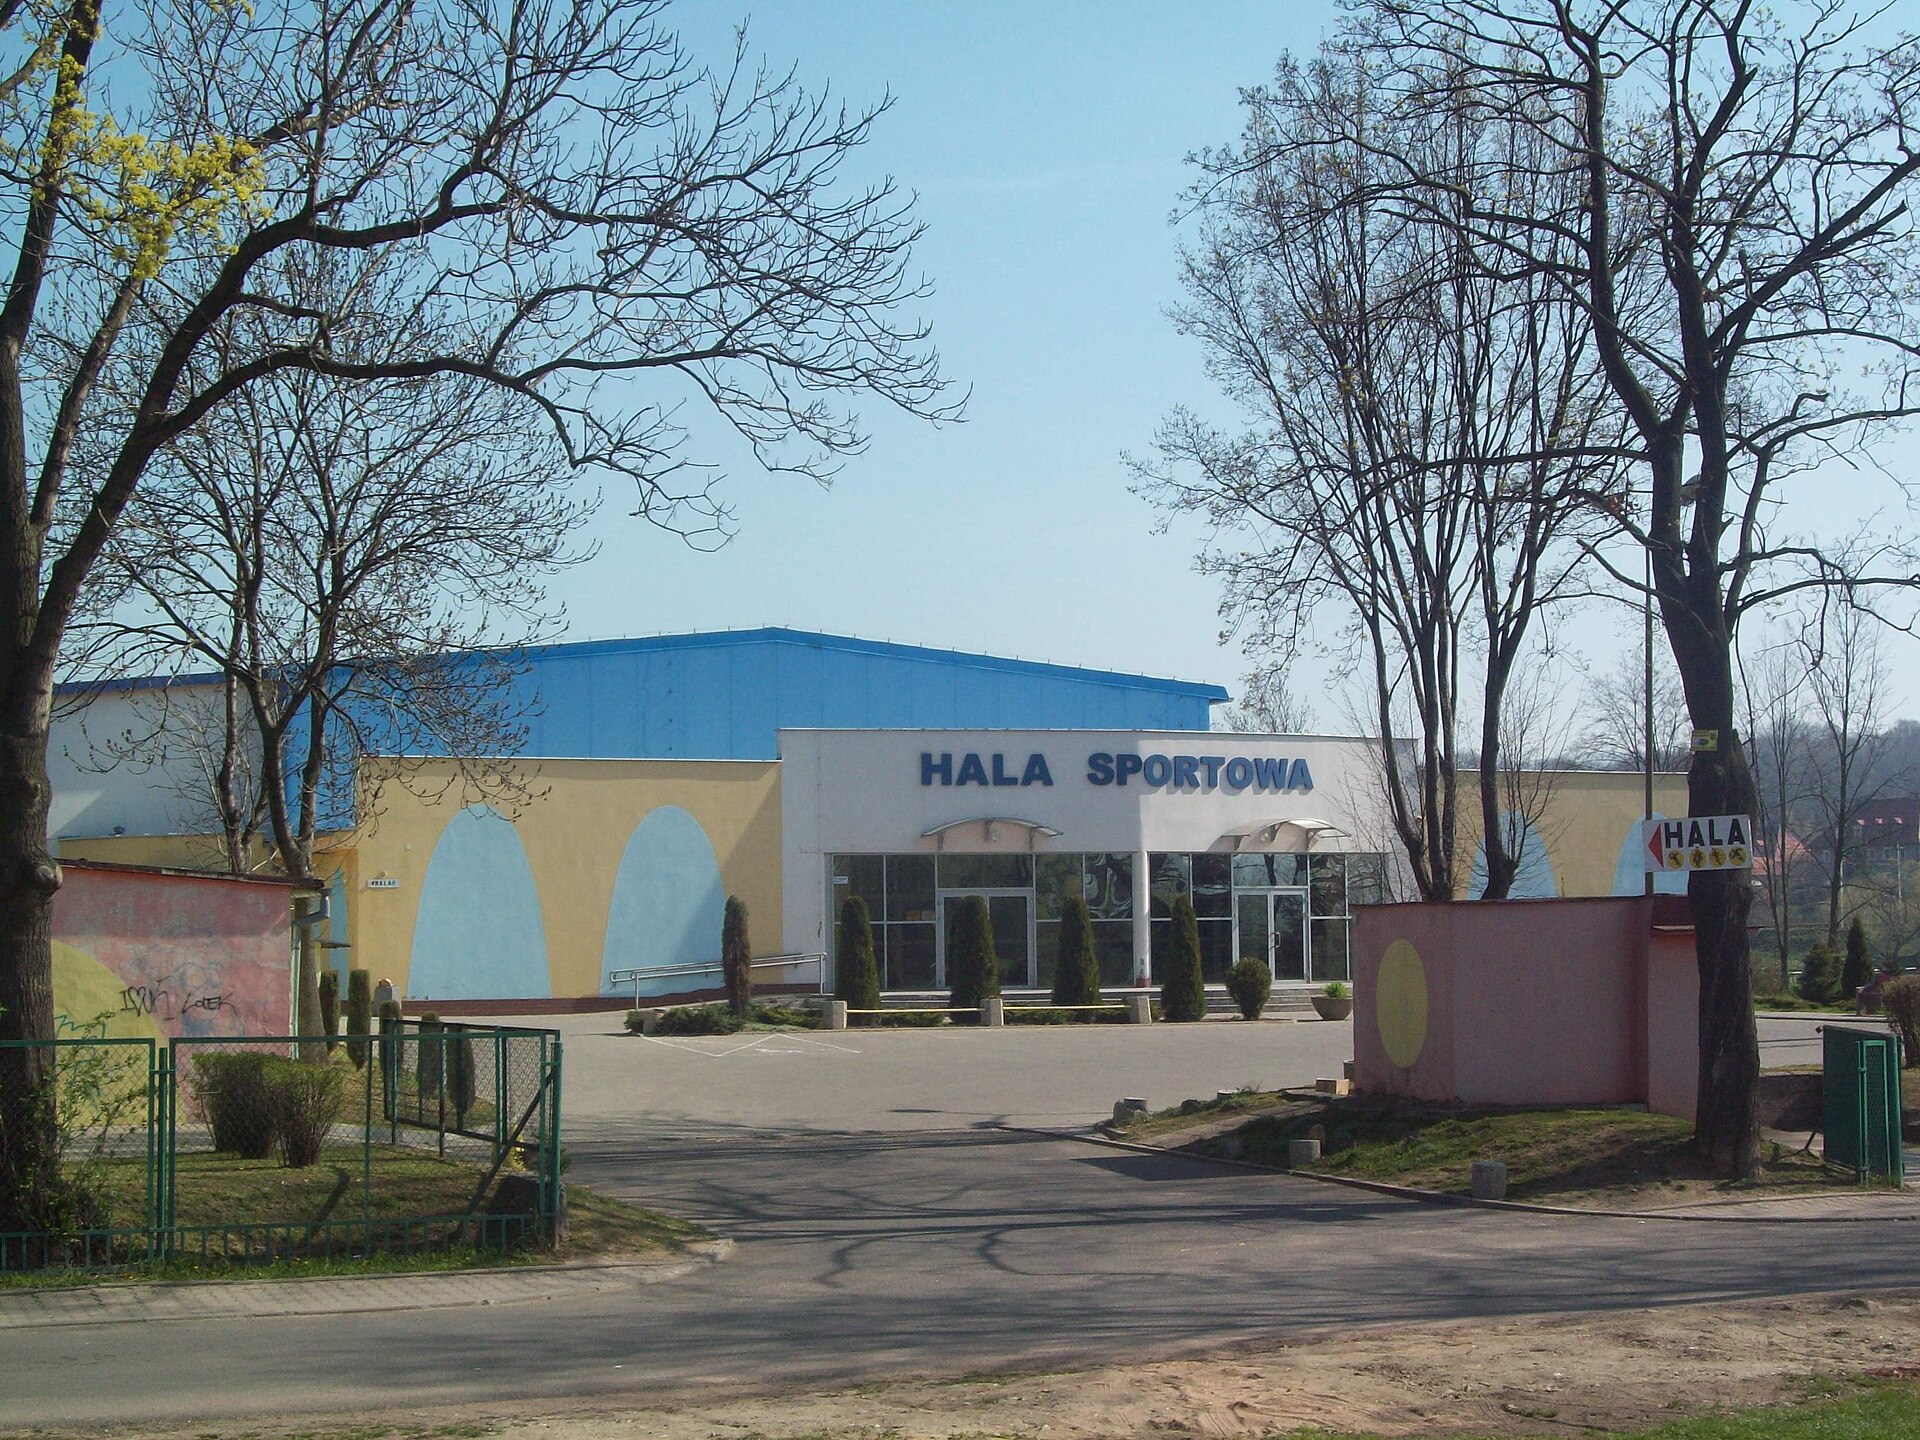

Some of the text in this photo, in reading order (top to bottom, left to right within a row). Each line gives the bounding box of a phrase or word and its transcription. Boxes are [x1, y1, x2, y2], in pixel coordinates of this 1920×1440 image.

[921, 753, 1314, 790] HALA SPORTOWA
[1665, 818, 1746, 848] HALA
